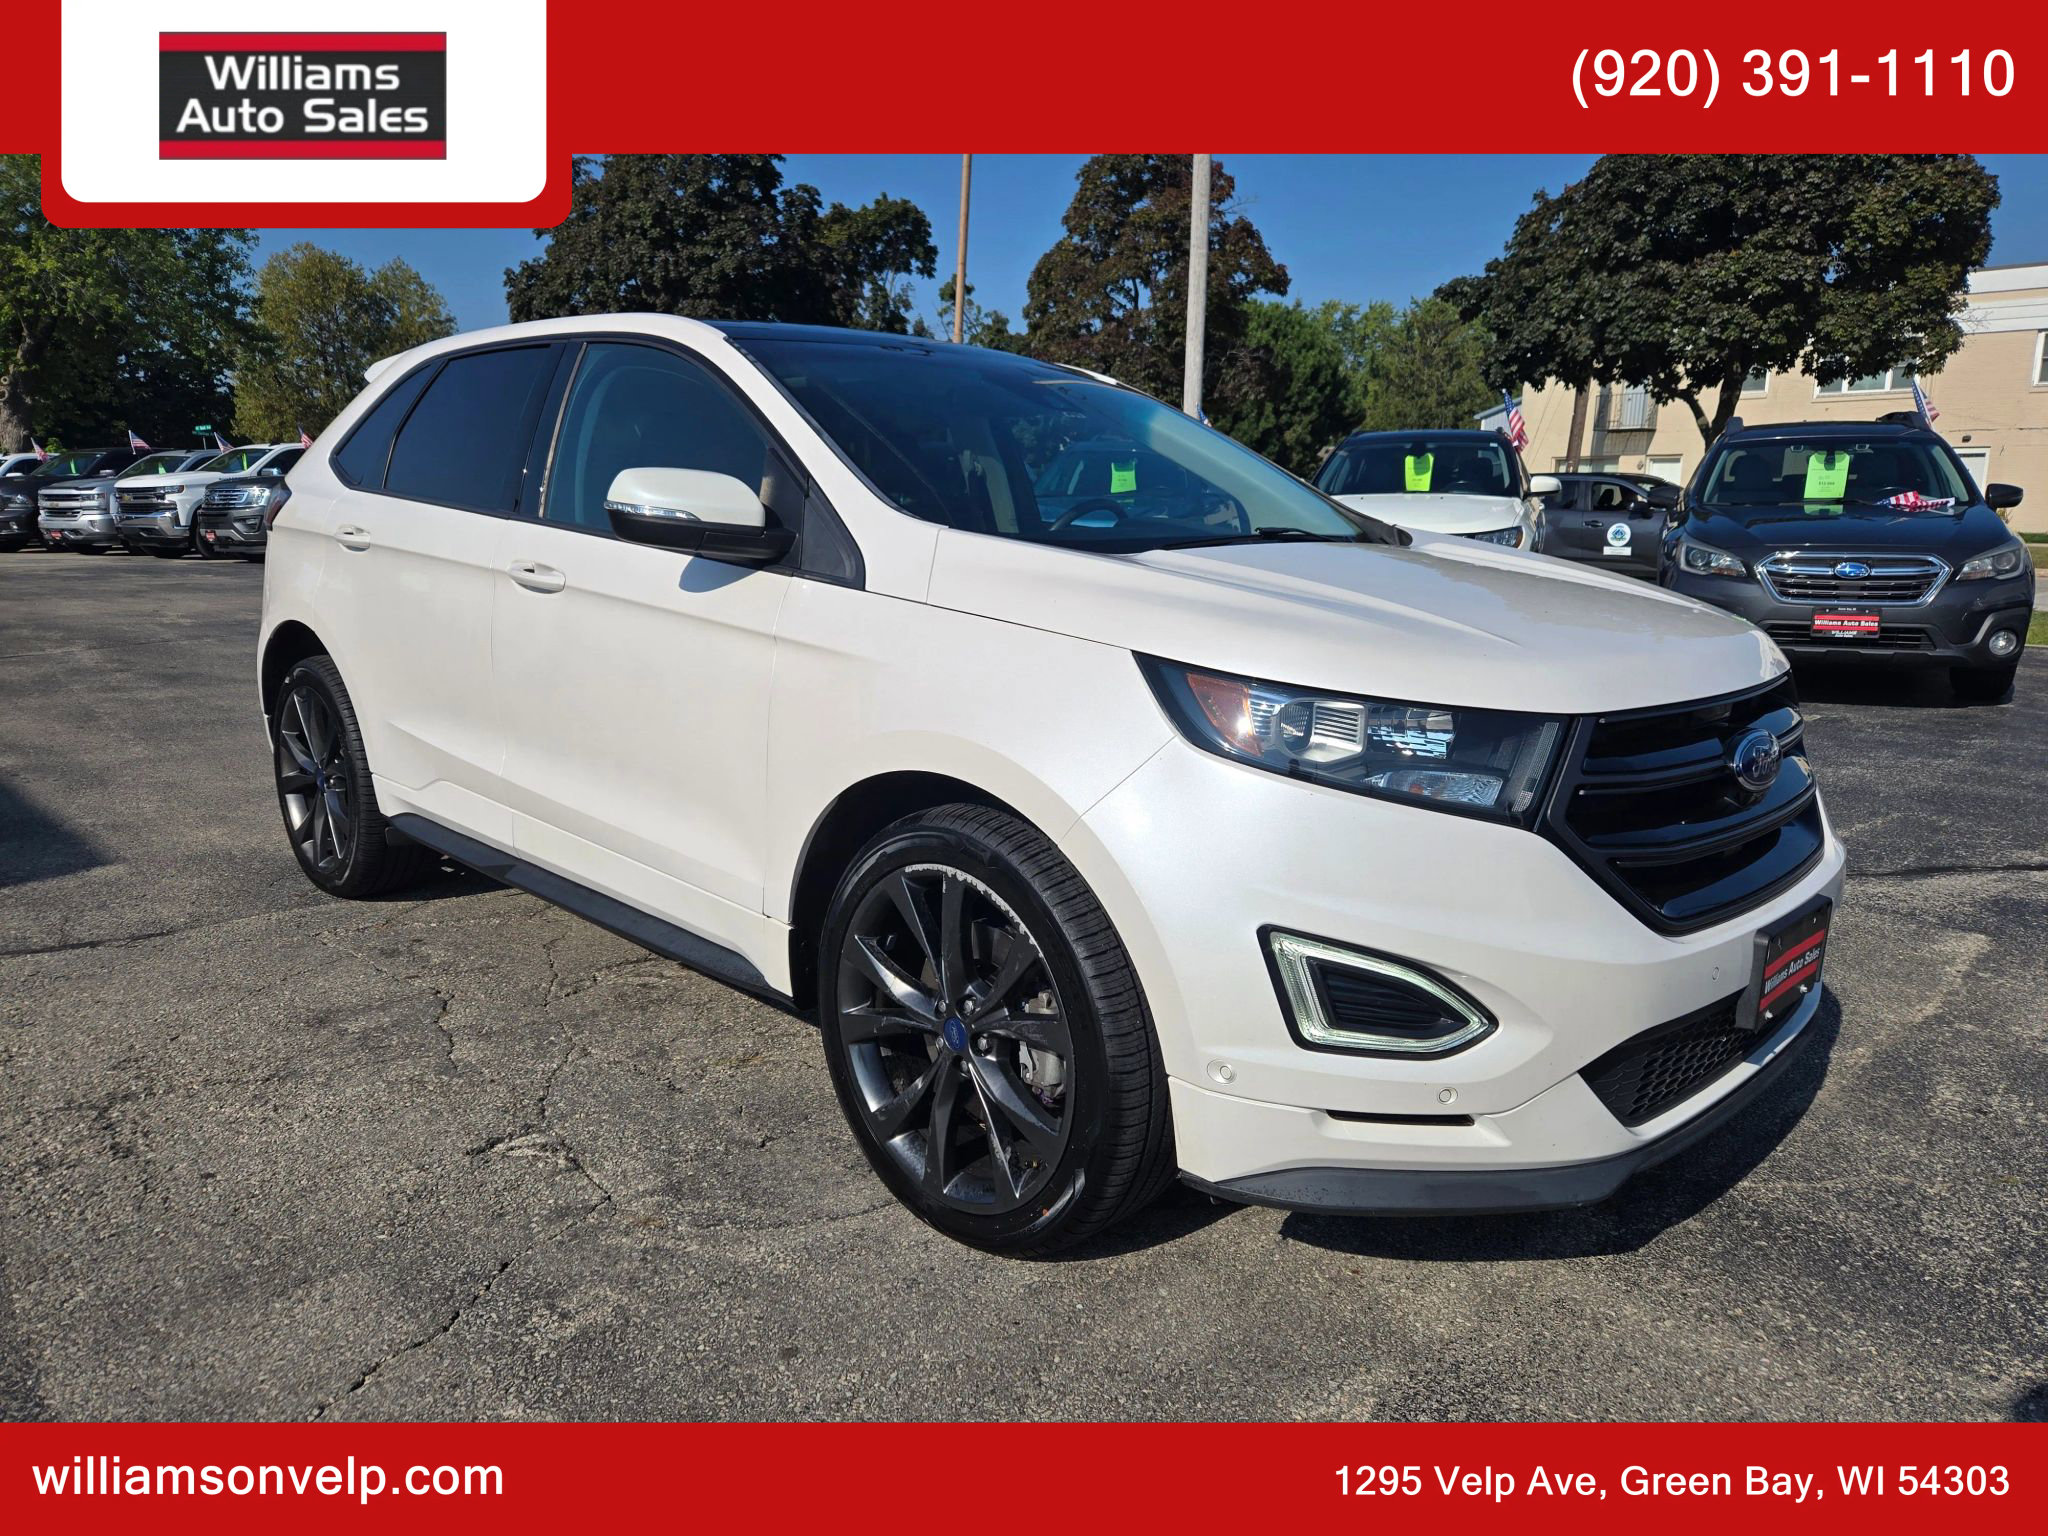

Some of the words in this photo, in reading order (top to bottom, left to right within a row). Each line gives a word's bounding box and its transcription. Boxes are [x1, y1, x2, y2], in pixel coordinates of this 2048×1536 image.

[1764, 967, 1789, 995] Williams
[1788, 958, 1804, 977] Auto
[1803, 947, 1821, 969] Sales
